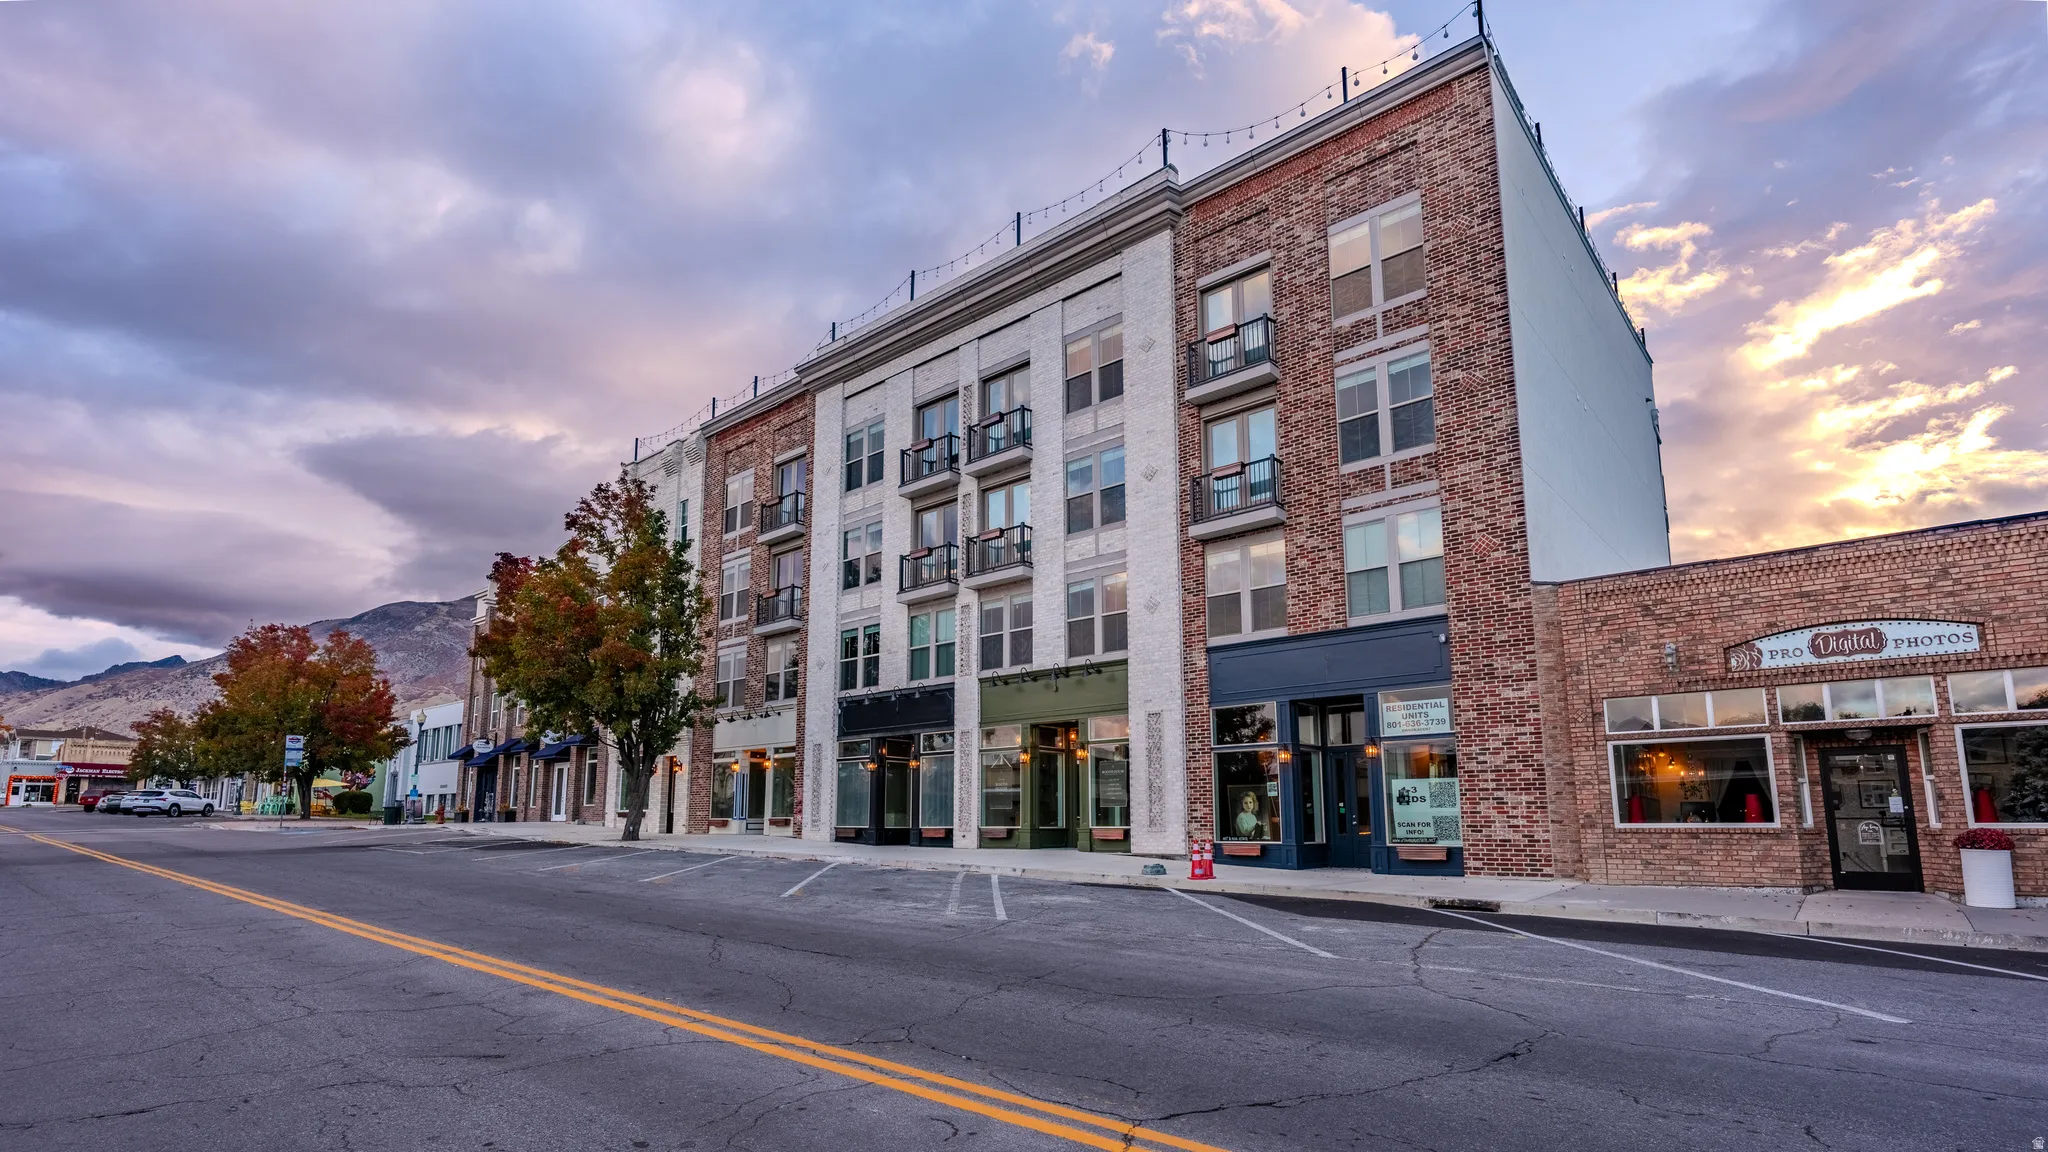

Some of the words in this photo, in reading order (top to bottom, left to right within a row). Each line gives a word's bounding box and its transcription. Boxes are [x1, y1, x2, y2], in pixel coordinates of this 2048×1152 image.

[1768, 646, 1804, 660] PRO
[1815, 632, 1881, 656] Digital
[1892, 632, 1974, 649] PHOTOS
[1386, 701, 1445, 712] RESIDENTIAL
[1402, 711, 1430, 720] UNITS
[1386, 717, 1447, 729] 801-636-3739
[1411, 785, 1418, 793] 3
